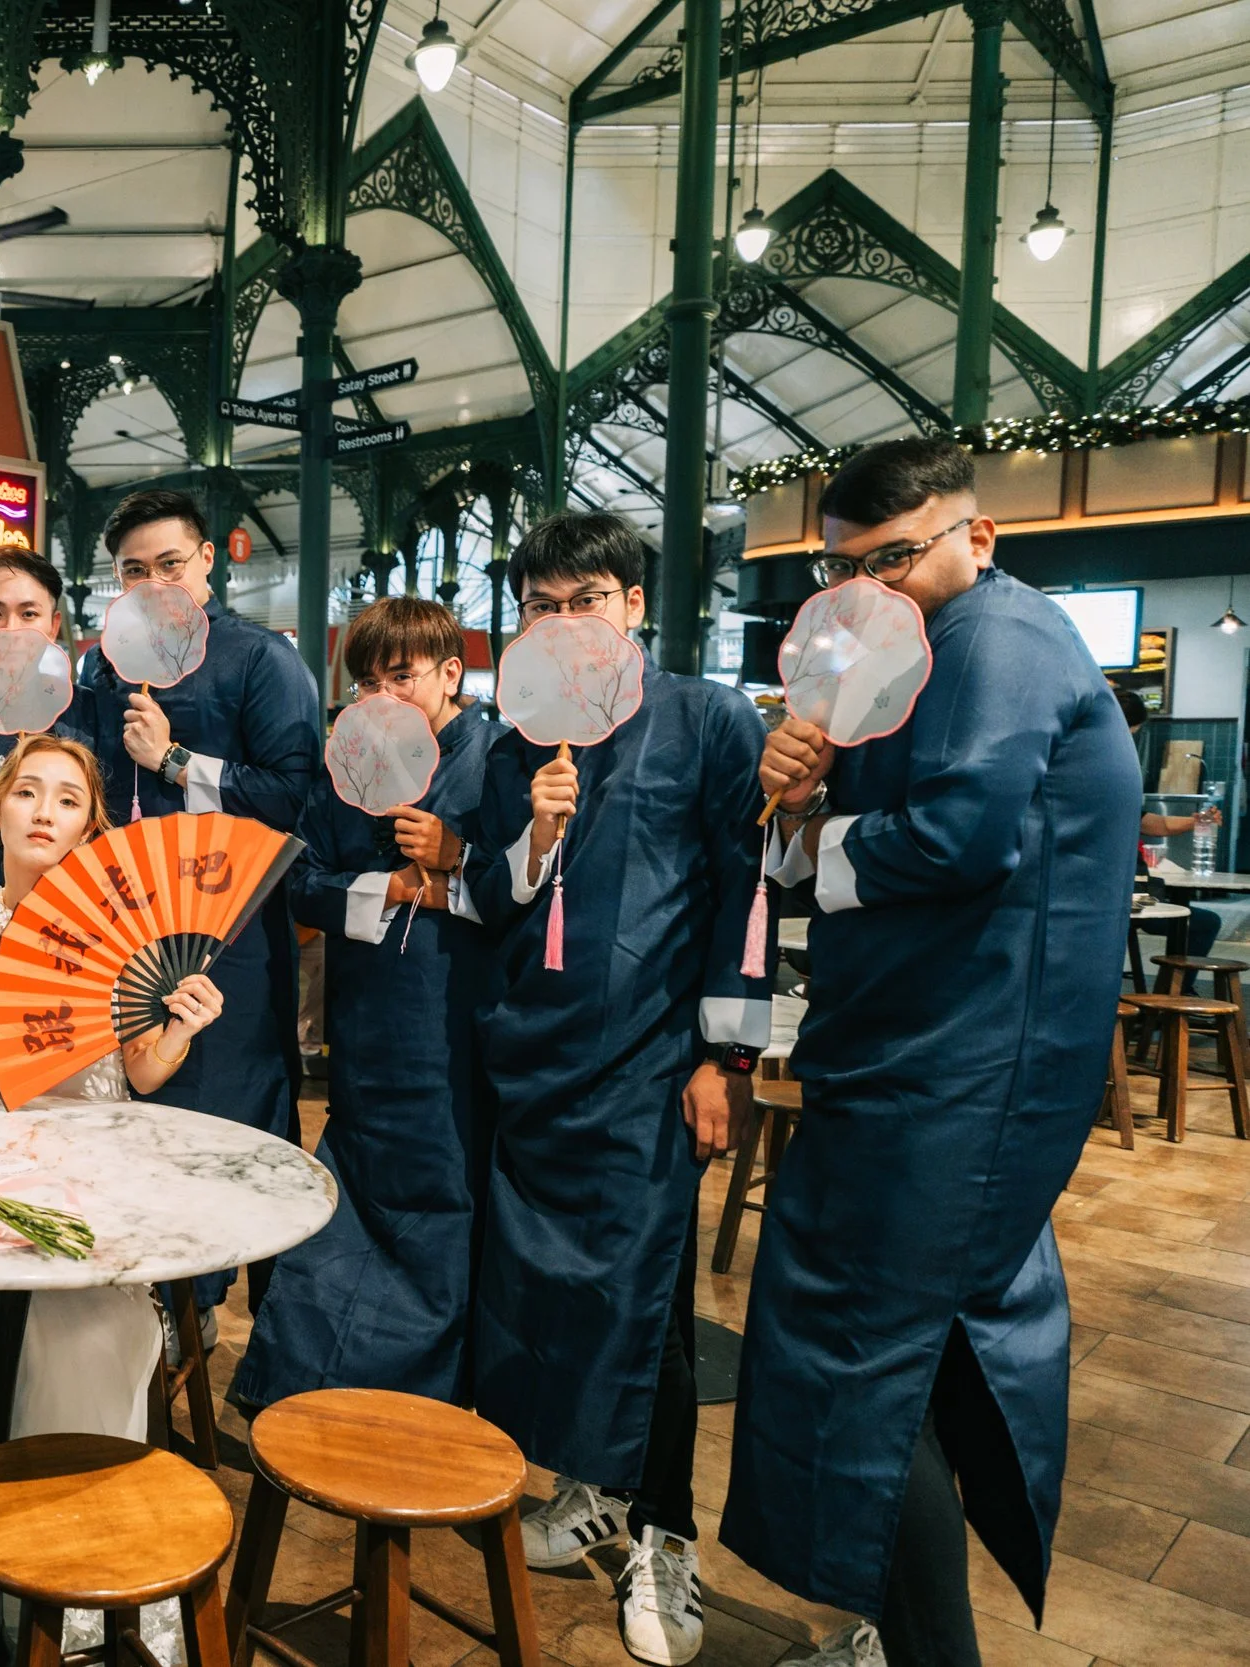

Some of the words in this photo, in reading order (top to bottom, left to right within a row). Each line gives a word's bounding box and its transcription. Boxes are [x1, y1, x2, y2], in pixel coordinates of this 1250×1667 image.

[337, 376, 366, 394] Satay
[368, 367, 400, 387] Street
[232, 403, 256, 420] Telok
[257, 408, 277, 424] Ayer
[279, 411, 298, 425] MRT
[338, 431, 393, 451] Restrooms
[22, 849, 233, 1057] 跟我走吧
